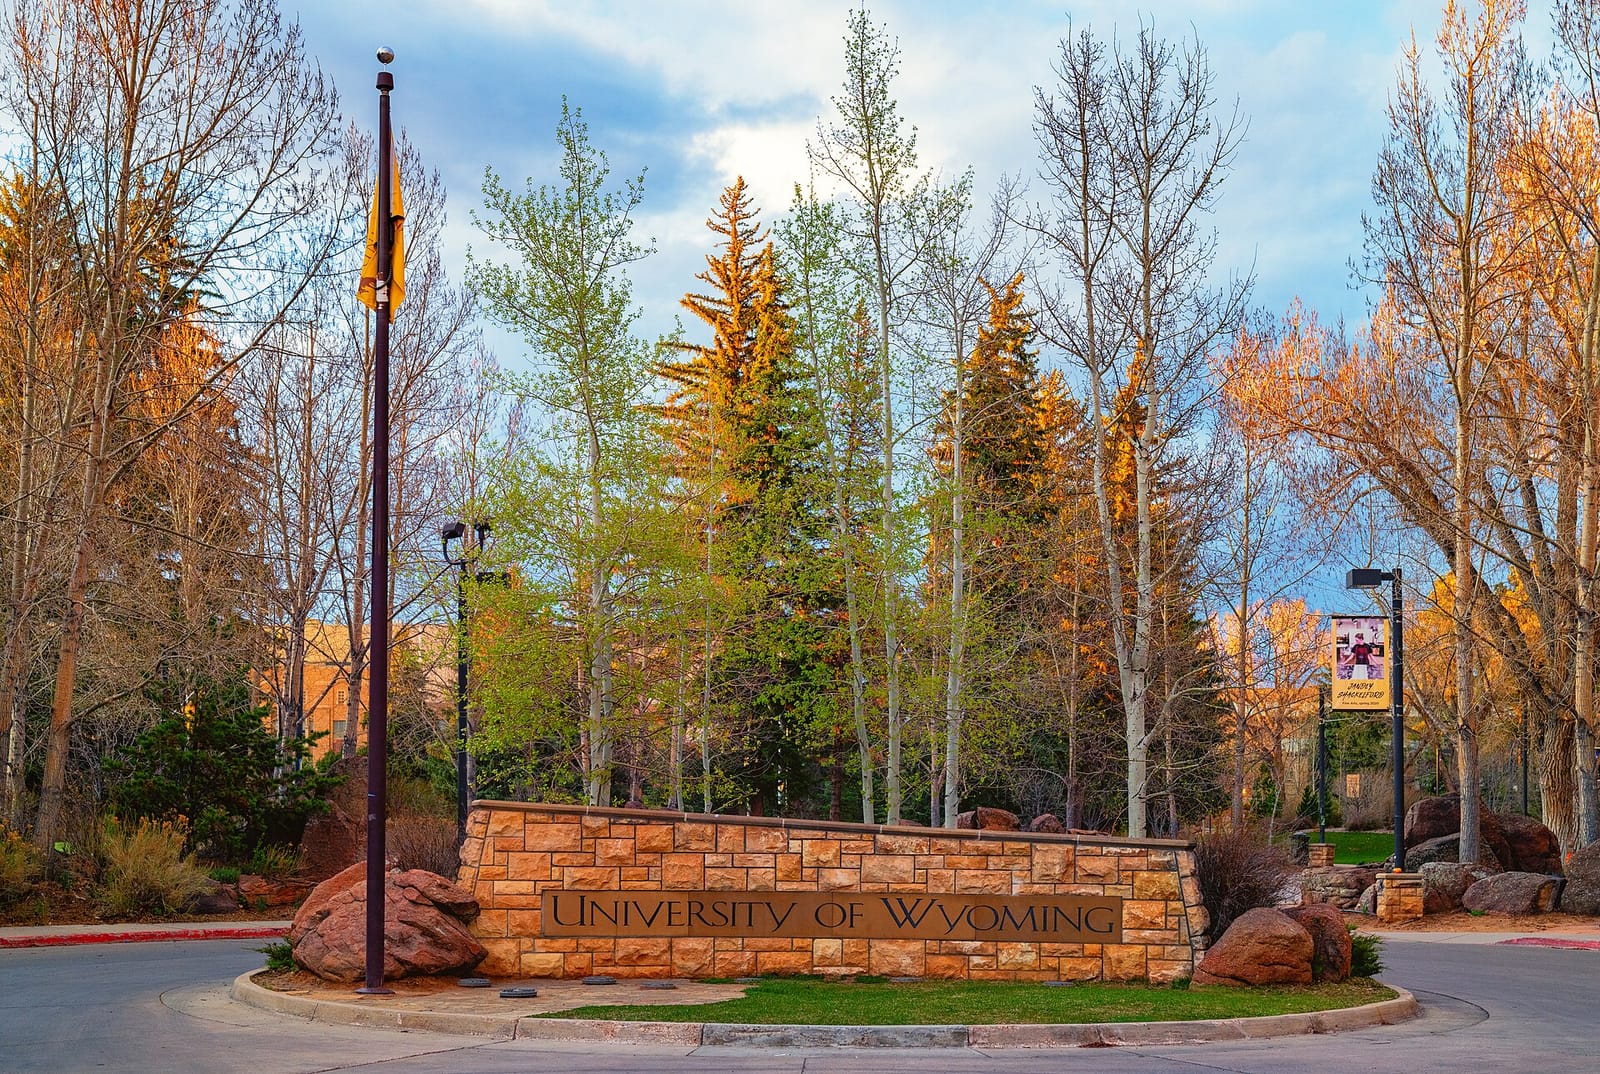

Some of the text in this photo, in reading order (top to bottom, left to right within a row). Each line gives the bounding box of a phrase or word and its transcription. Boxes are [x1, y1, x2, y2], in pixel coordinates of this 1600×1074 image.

[552, 895, 1115, 935] UNIVERSITY OF WYOMING
